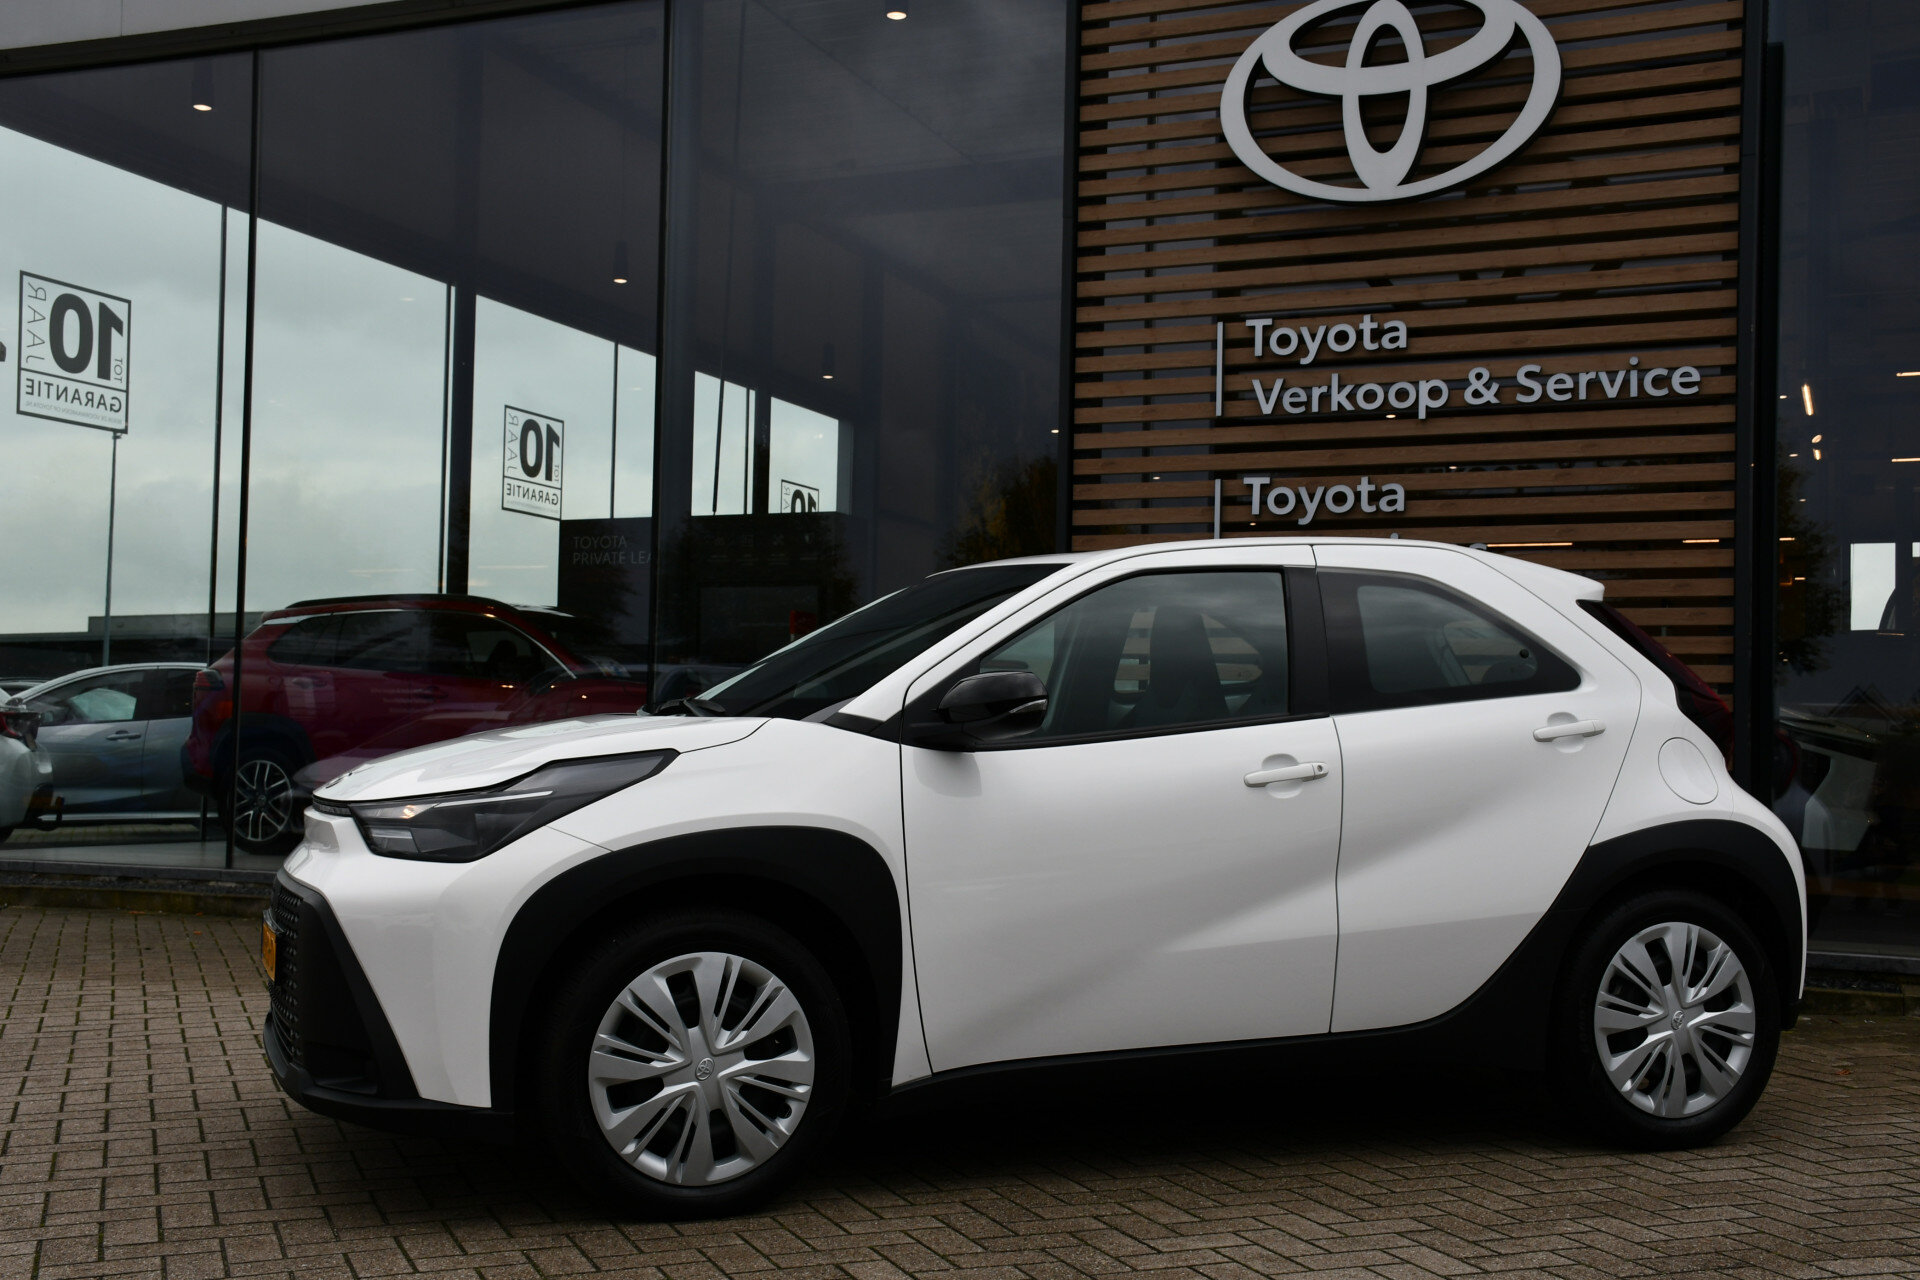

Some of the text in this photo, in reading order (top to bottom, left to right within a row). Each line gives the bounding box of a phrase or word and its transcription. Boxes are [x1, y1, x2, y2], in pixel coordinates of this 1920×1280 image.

[1246, 314, 1407, 364] Toyota
[1252, 356, 1701, 419] Verkoop & Service
[1243, 476, 1405, 525] Toyota
[573, 535, 628, 549] TOYOTA
[573, 551, 626, 566] PRIVATE
